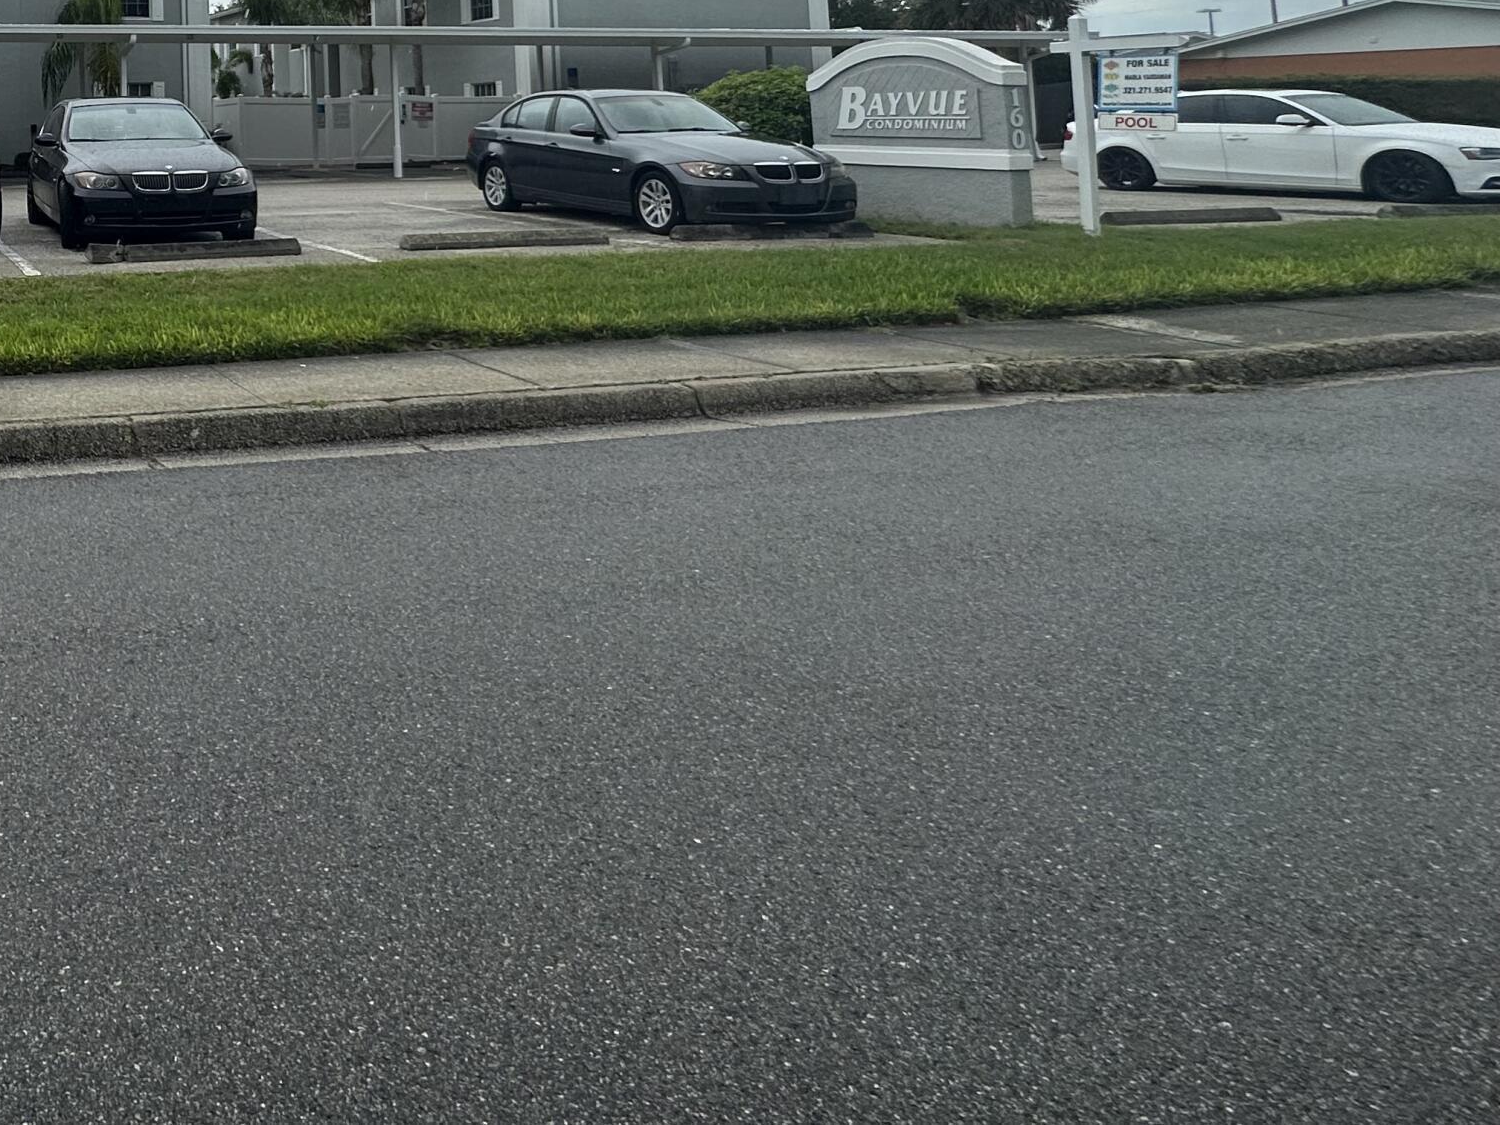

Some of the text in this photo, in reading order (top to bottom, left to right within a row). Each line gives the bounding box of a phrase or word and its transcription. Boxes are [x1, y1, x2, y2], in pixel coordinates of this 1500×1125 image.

[1147, 59, 1169, 67] SALE
[836, 86, 968, 130] BAYVUE
[866, 119, 967, 130] CONDOMINIUM
[1010, 88, 1026, 150] 160
[1115, 117, 1158, 128] POOL
